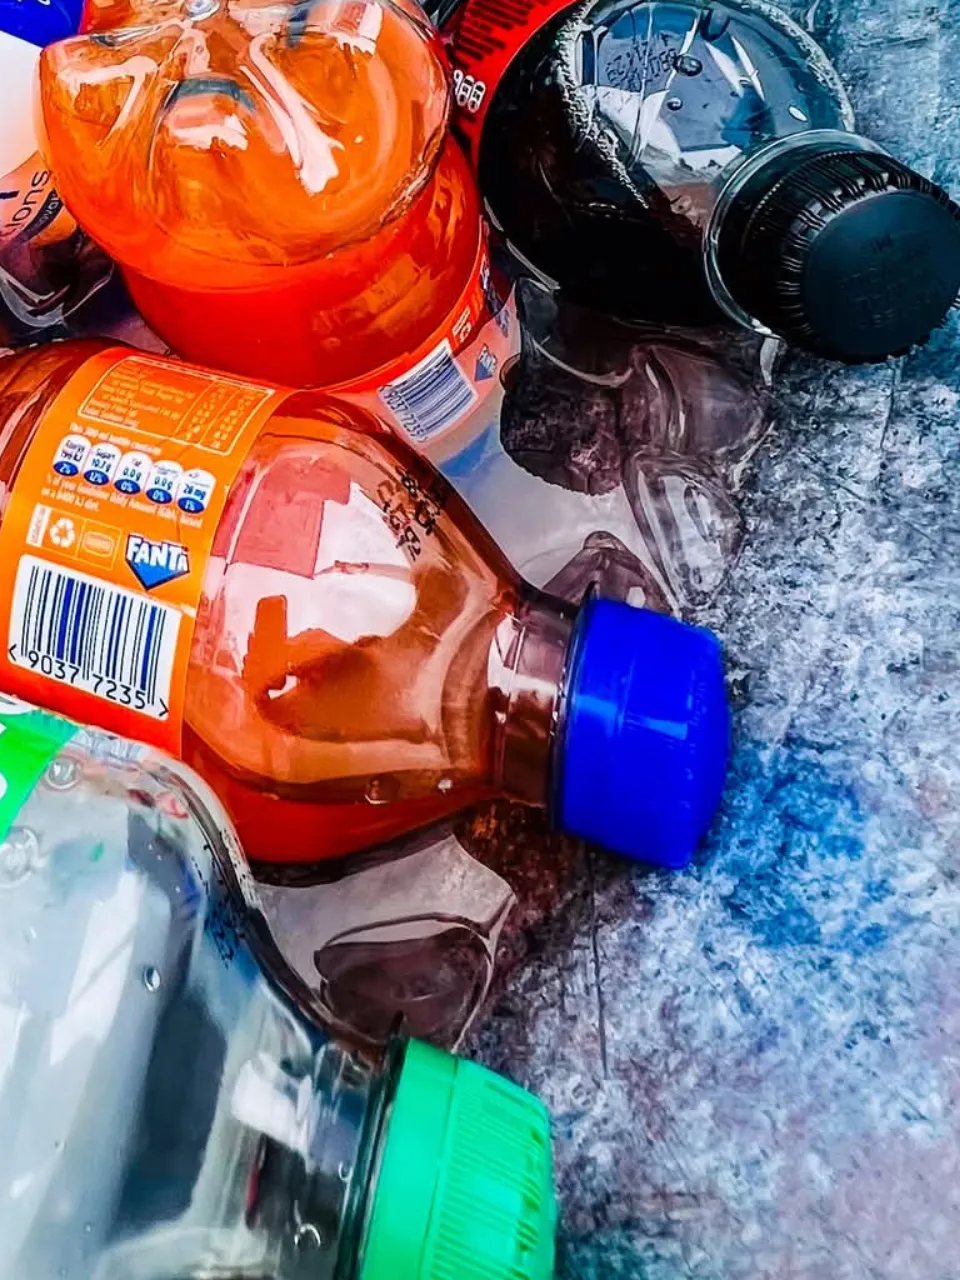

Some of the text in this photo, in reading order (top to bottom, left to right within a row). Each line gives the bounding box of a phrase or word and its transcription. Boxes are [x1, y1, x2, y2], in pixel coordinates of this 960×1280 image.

[127, 535, 190, 572] FANTA
[28, 650, 147, 710] 9037 7235
